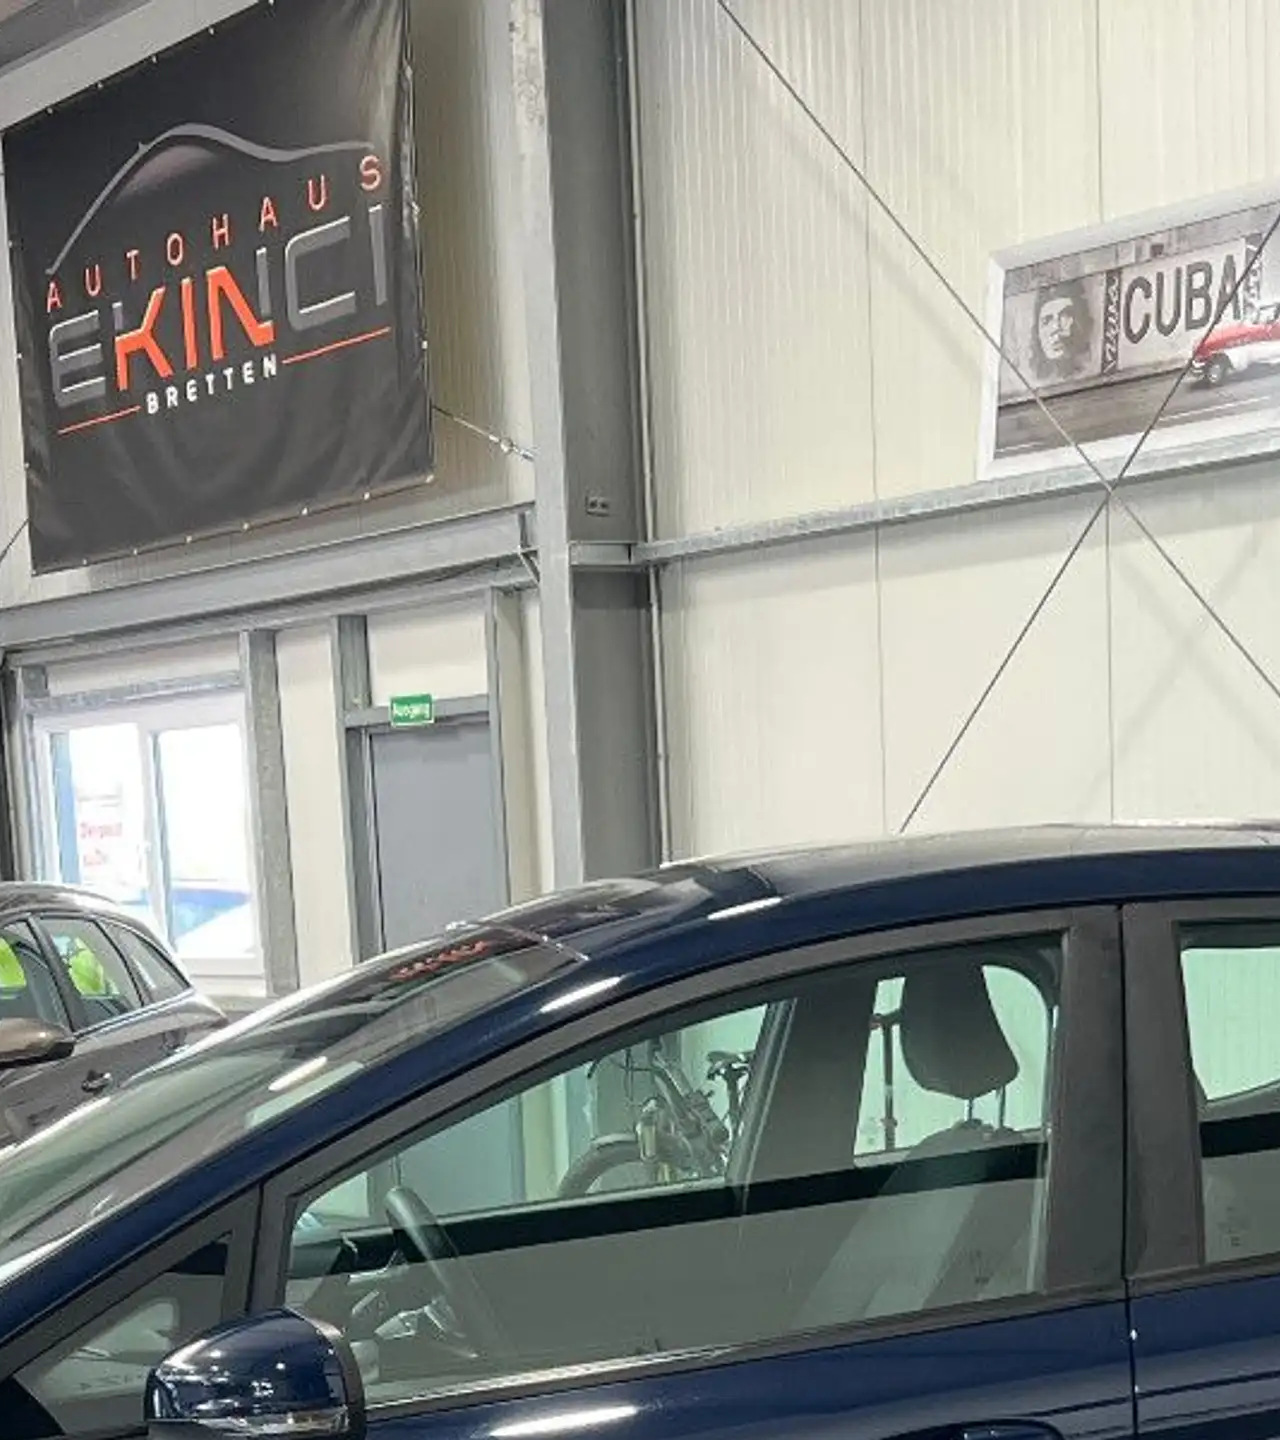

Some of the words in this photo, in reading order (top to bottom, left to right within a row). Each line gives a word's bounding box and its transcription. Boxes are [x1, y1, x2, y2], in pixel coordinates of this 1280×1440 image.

[46, 154, 382, 313] AUTOHAUS
[1123, 254, 1243, 345] CUBA
[146, 353, 278, 414] BRETTEN
